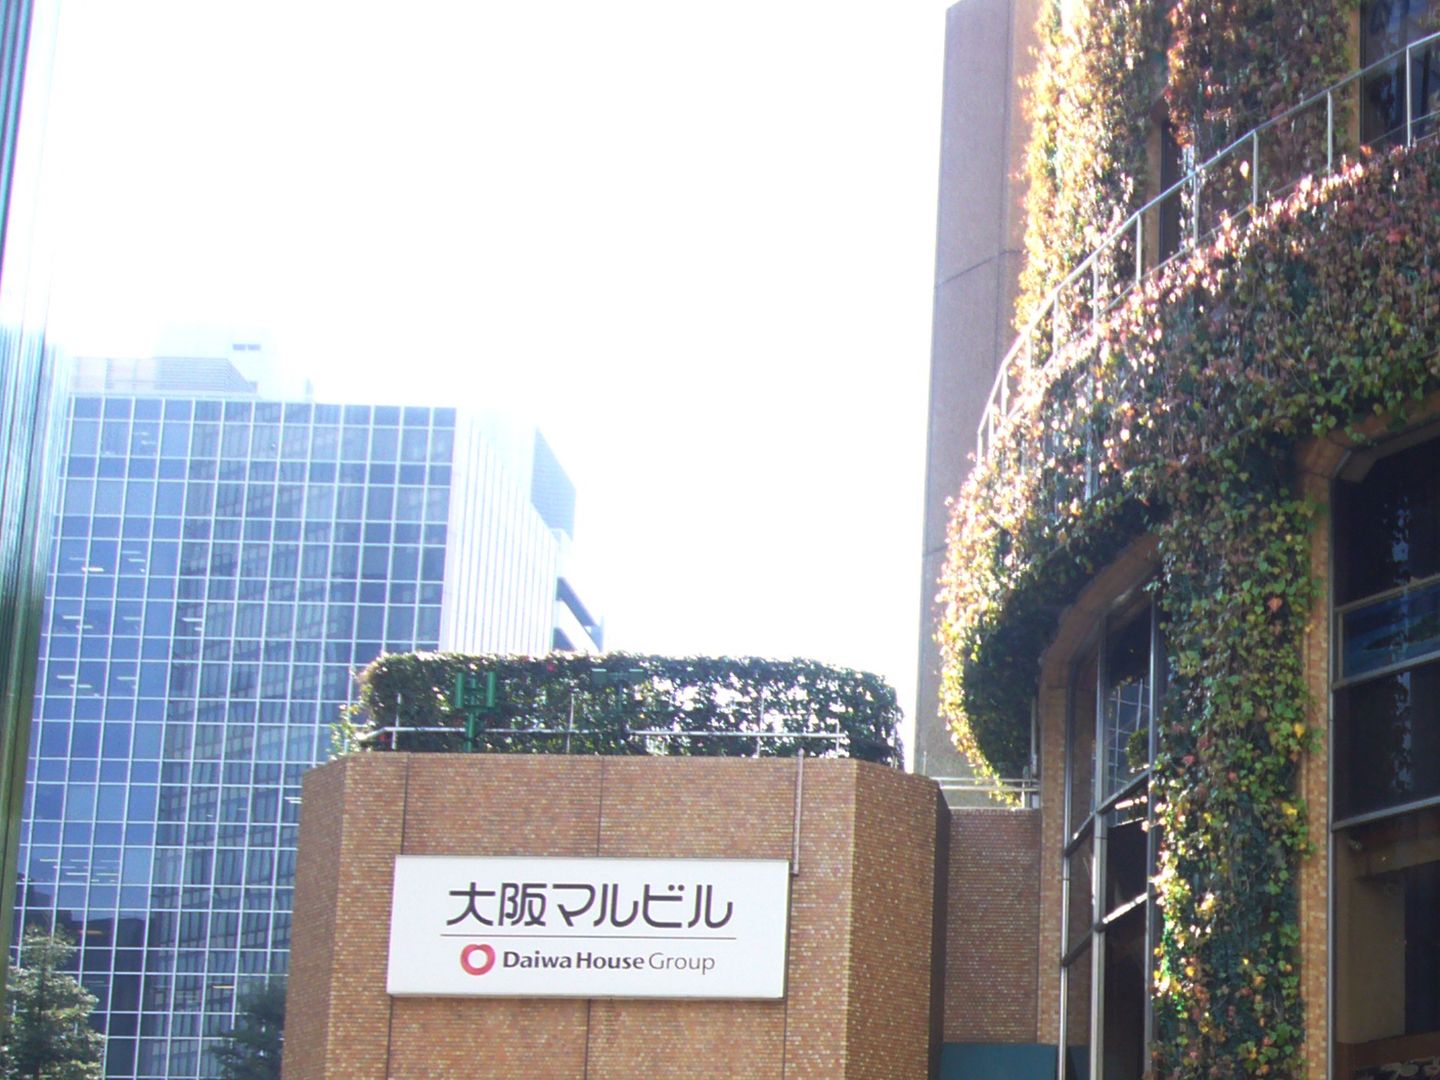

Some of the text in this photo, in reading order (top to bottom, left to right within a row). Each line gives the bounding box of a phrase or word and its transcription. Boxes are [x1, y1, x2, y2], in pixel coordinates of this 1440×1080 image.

[445, 880, 734, 929] 大阪マルビル
[503, 950, 716, 975] Daiwa House Group
